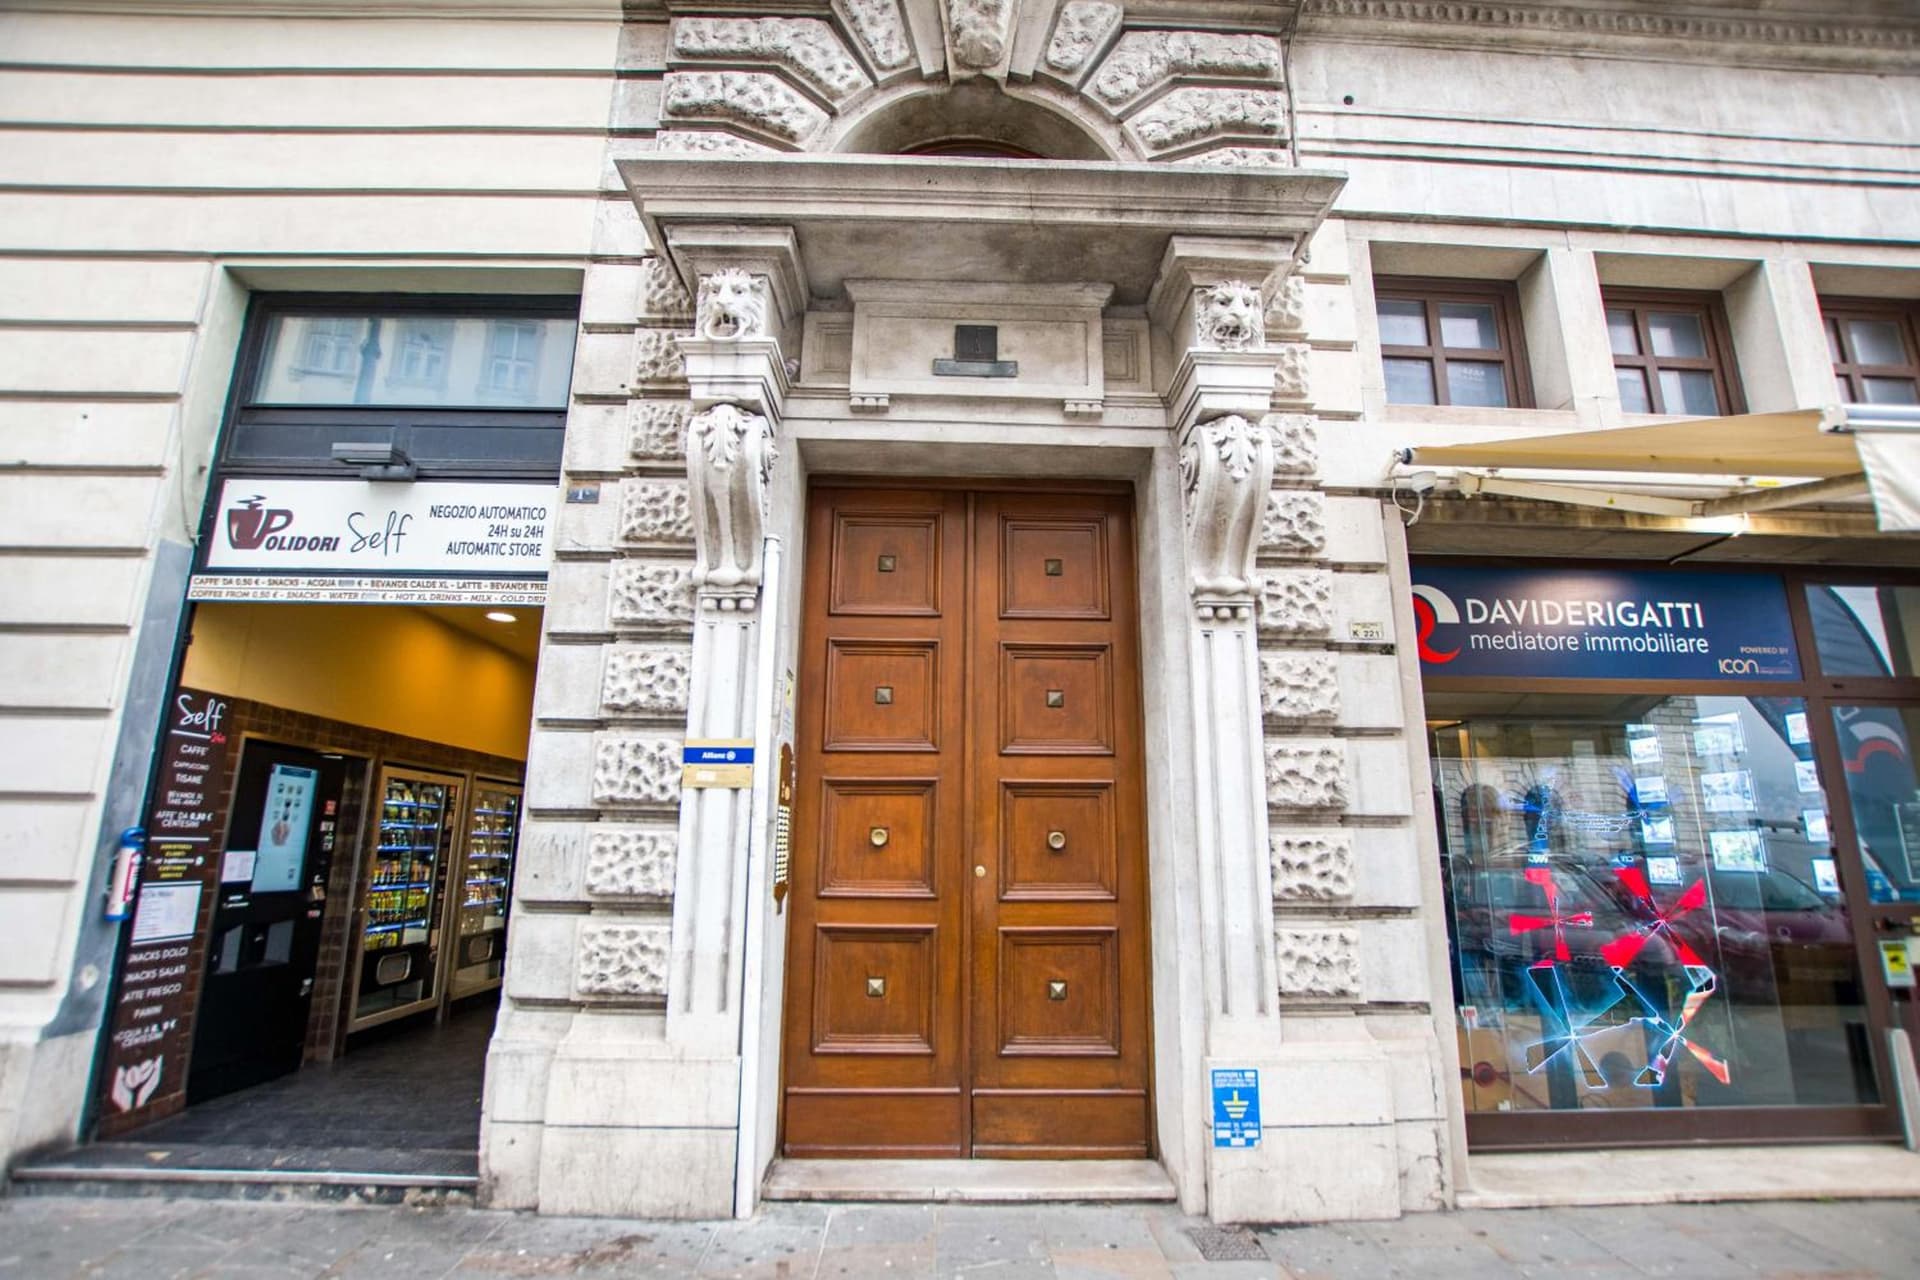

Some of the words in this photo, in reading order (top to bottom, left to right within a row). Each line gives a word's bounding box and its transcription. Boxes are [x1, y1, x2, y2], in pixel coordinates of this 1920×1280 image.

[430, 505, 477, 519] NEGOZIO
[478, 505, 547, 521] AUTOMATICO
[253, 508, 341, 551] POLIDORI
[347, 510, 413, 556] Self
[488, 524, 508, 538] 24H
[511, 528, 522, 538] su
[523, 525, 545, 538] 24H
[446, 541, 506, 556] AUTOMATIC
[508, 543, 542, 557] STORE
[307, 579, 336, 588] ACQUA
[456, 582, 482, 590] LATTE
[1465, 598, 1705, 628] DAVIDERIGATTI
[1470, 631, 1580, 652] mediatore
[1584, 632, 1709, 654] immobiliare
[177, 694, 227, 732] Self
[702, 751, 726, 760] Allianz
[128, 949, 161, 963] NACKS
[123, 968, 158, 984] NACKS
[121, 988, 145, 1003] ATTE
